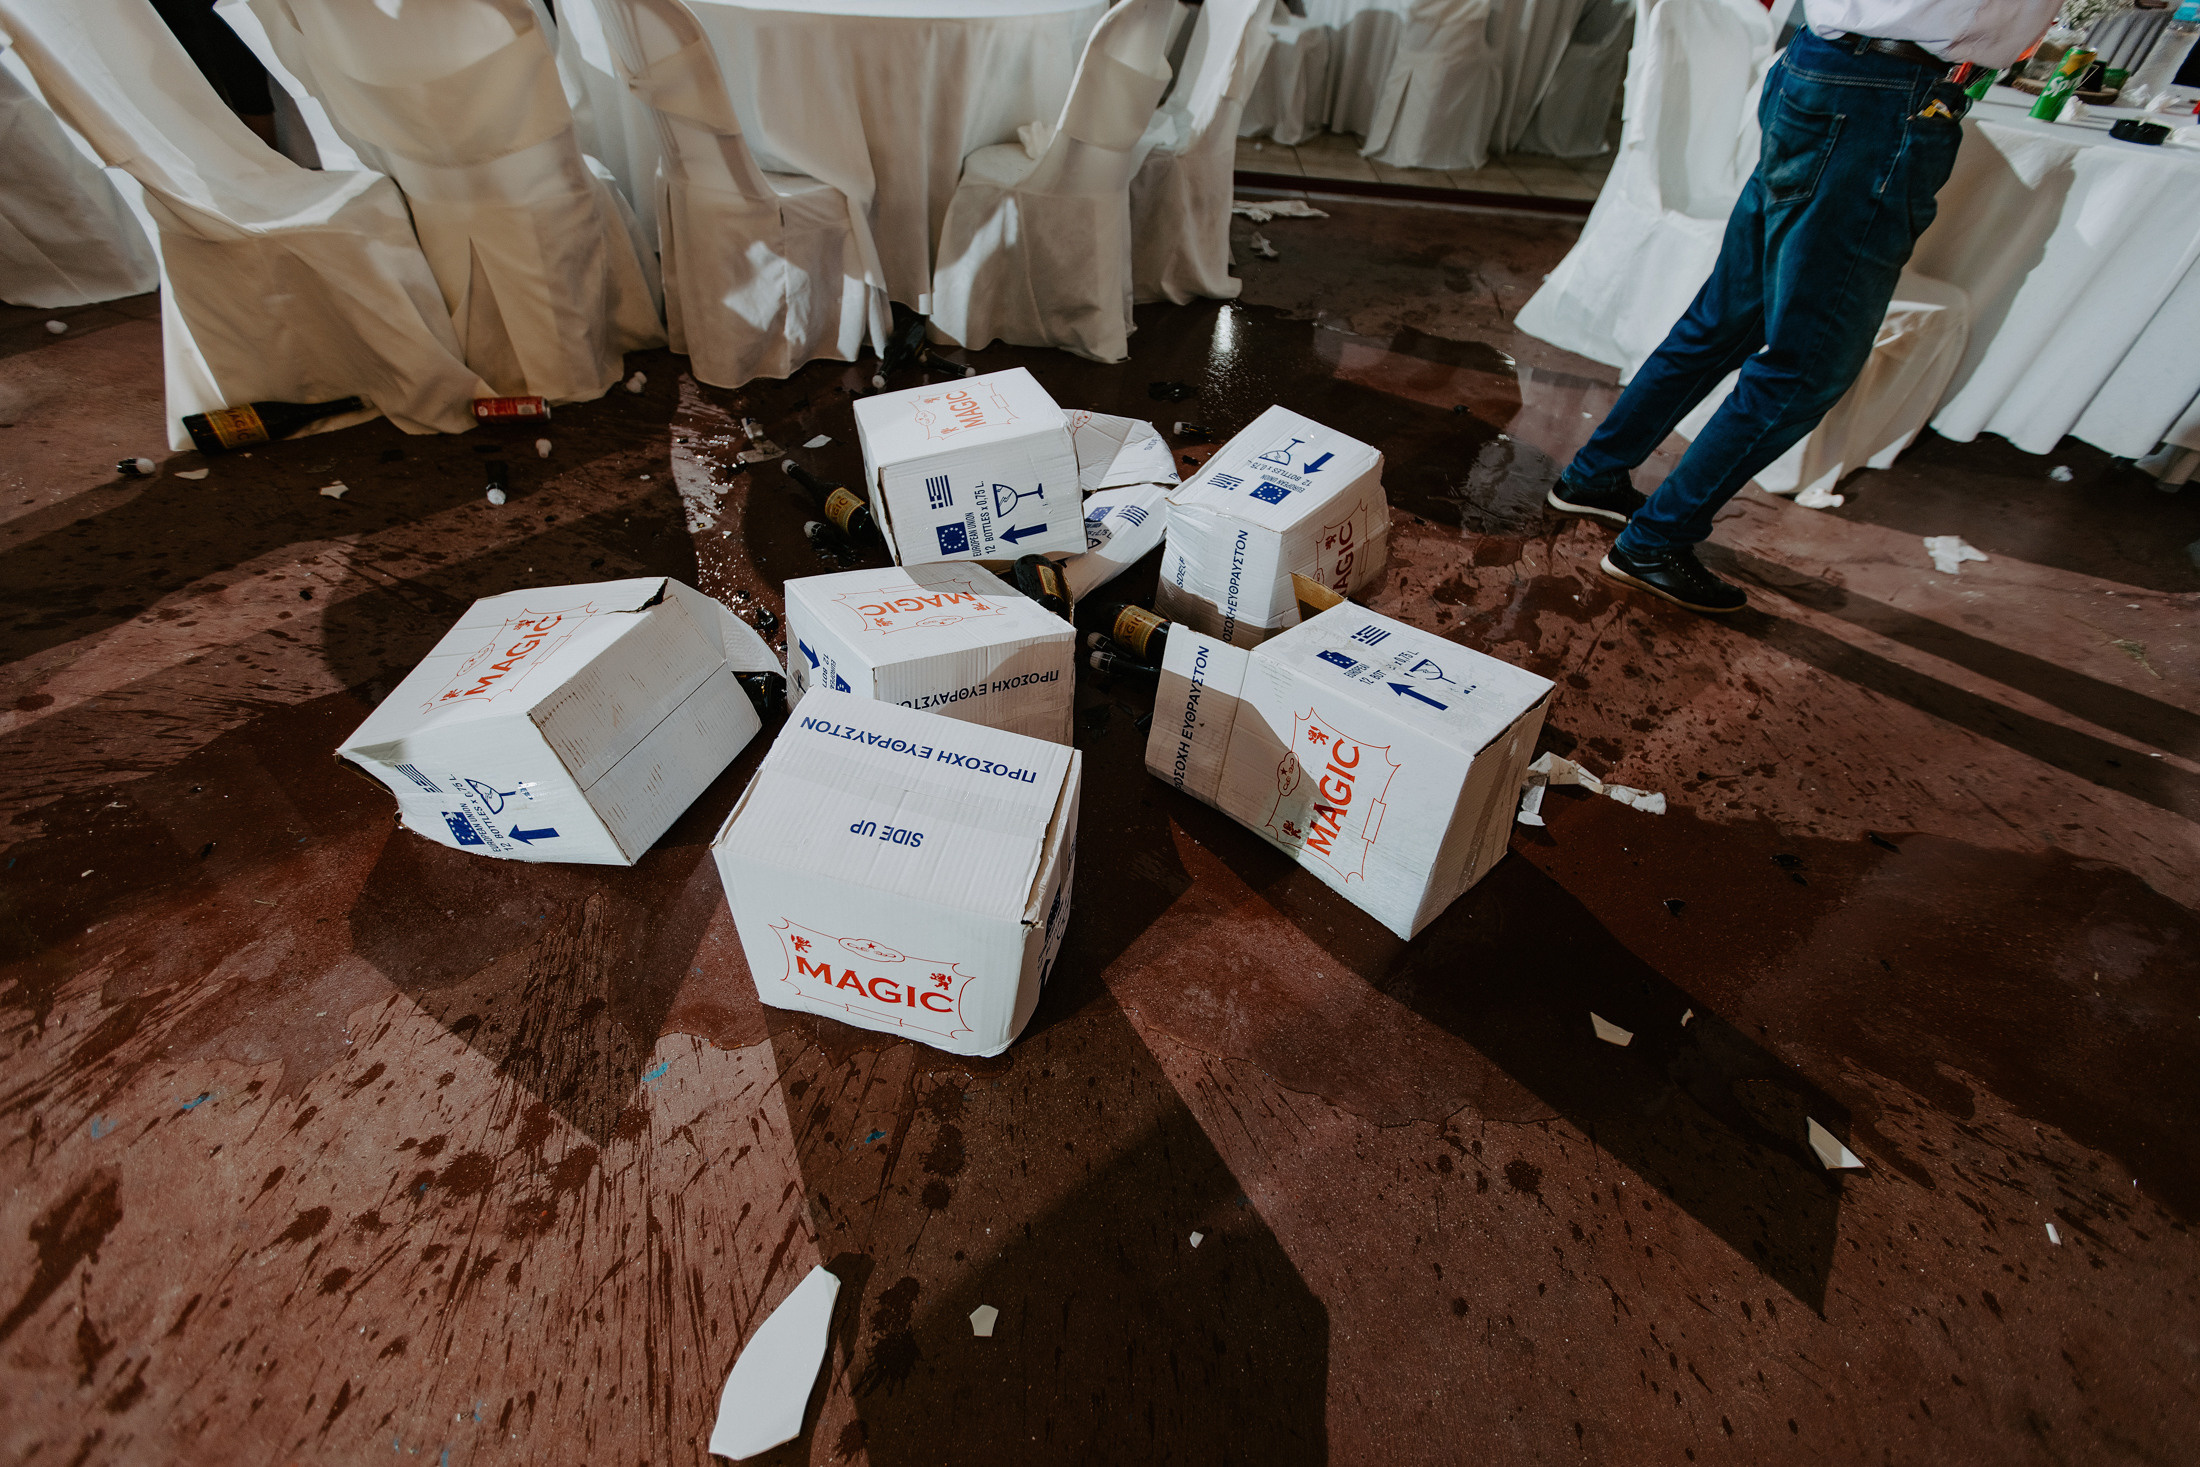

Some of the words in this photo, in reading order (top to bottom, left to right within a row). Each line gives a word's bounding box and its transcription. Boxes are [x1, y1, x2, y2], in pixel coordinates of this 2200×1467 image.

[946, 391, 987, 429] MAGIC
[1271, 467, 1302, 482] BOTTLES
[1277, 479, 1306, 494] EUROPEAN
[1302, 479, 1312, 487] 12
[965, 511, 977, 530] UNION
[980, 511, 994, 542] BOTTLES
[968, 529, 982, 557] EUROPEAN
[984, 544, 996, 554] 12
[1227, 529, 1249, 607] ΕΥΘΡΑΥΣΤΟΝ
[1333, 520, 1354, 597] AGIC
[857, 591, 977, 616] MAGIC
[1222, 606, 1237, 642] ΟΣΟΧΗ
[463, 614, 563, 697] MAGIC
[822, 653, 830, 666] 12
[821, 667, 829, 688] BOTT
[829, 659, 837, 689] EUROPEA
[992, 670, 1060, 693] ΠΡΟΣΟΧΗ
[1343, 663, 1370, 679] EUROPEA
[1359, 676, 1374, 685] 12
[896, 683, 988, 710] ΕΥΘΡΑΥΣΤΟ
[1181, 645, 1209, 741] ΕΥΘΡΑΥΣΤΟΝ
[800, 716, 935, 760] ΕΥΘΡΑΥΣΤΟΝ
[936, 750, 1037, 784] ΠΡΟΣΟΧΗ
[1173, 741, 1191, 790] ΡΟΣΟΧΗ
[1306, 738, 1360, 857] MAGIC
[460, 802, 478, 823] UNION
[474, 806, 504, 839] BOTTLES
[473, 822, 502, 853] EUROPEAN
[850, 819, 877, 838] UP
[879, 824, 924, 848] SIDE
[500, 842, 514, 852] 12
[795, 955, 955, 1013] MAGIC
